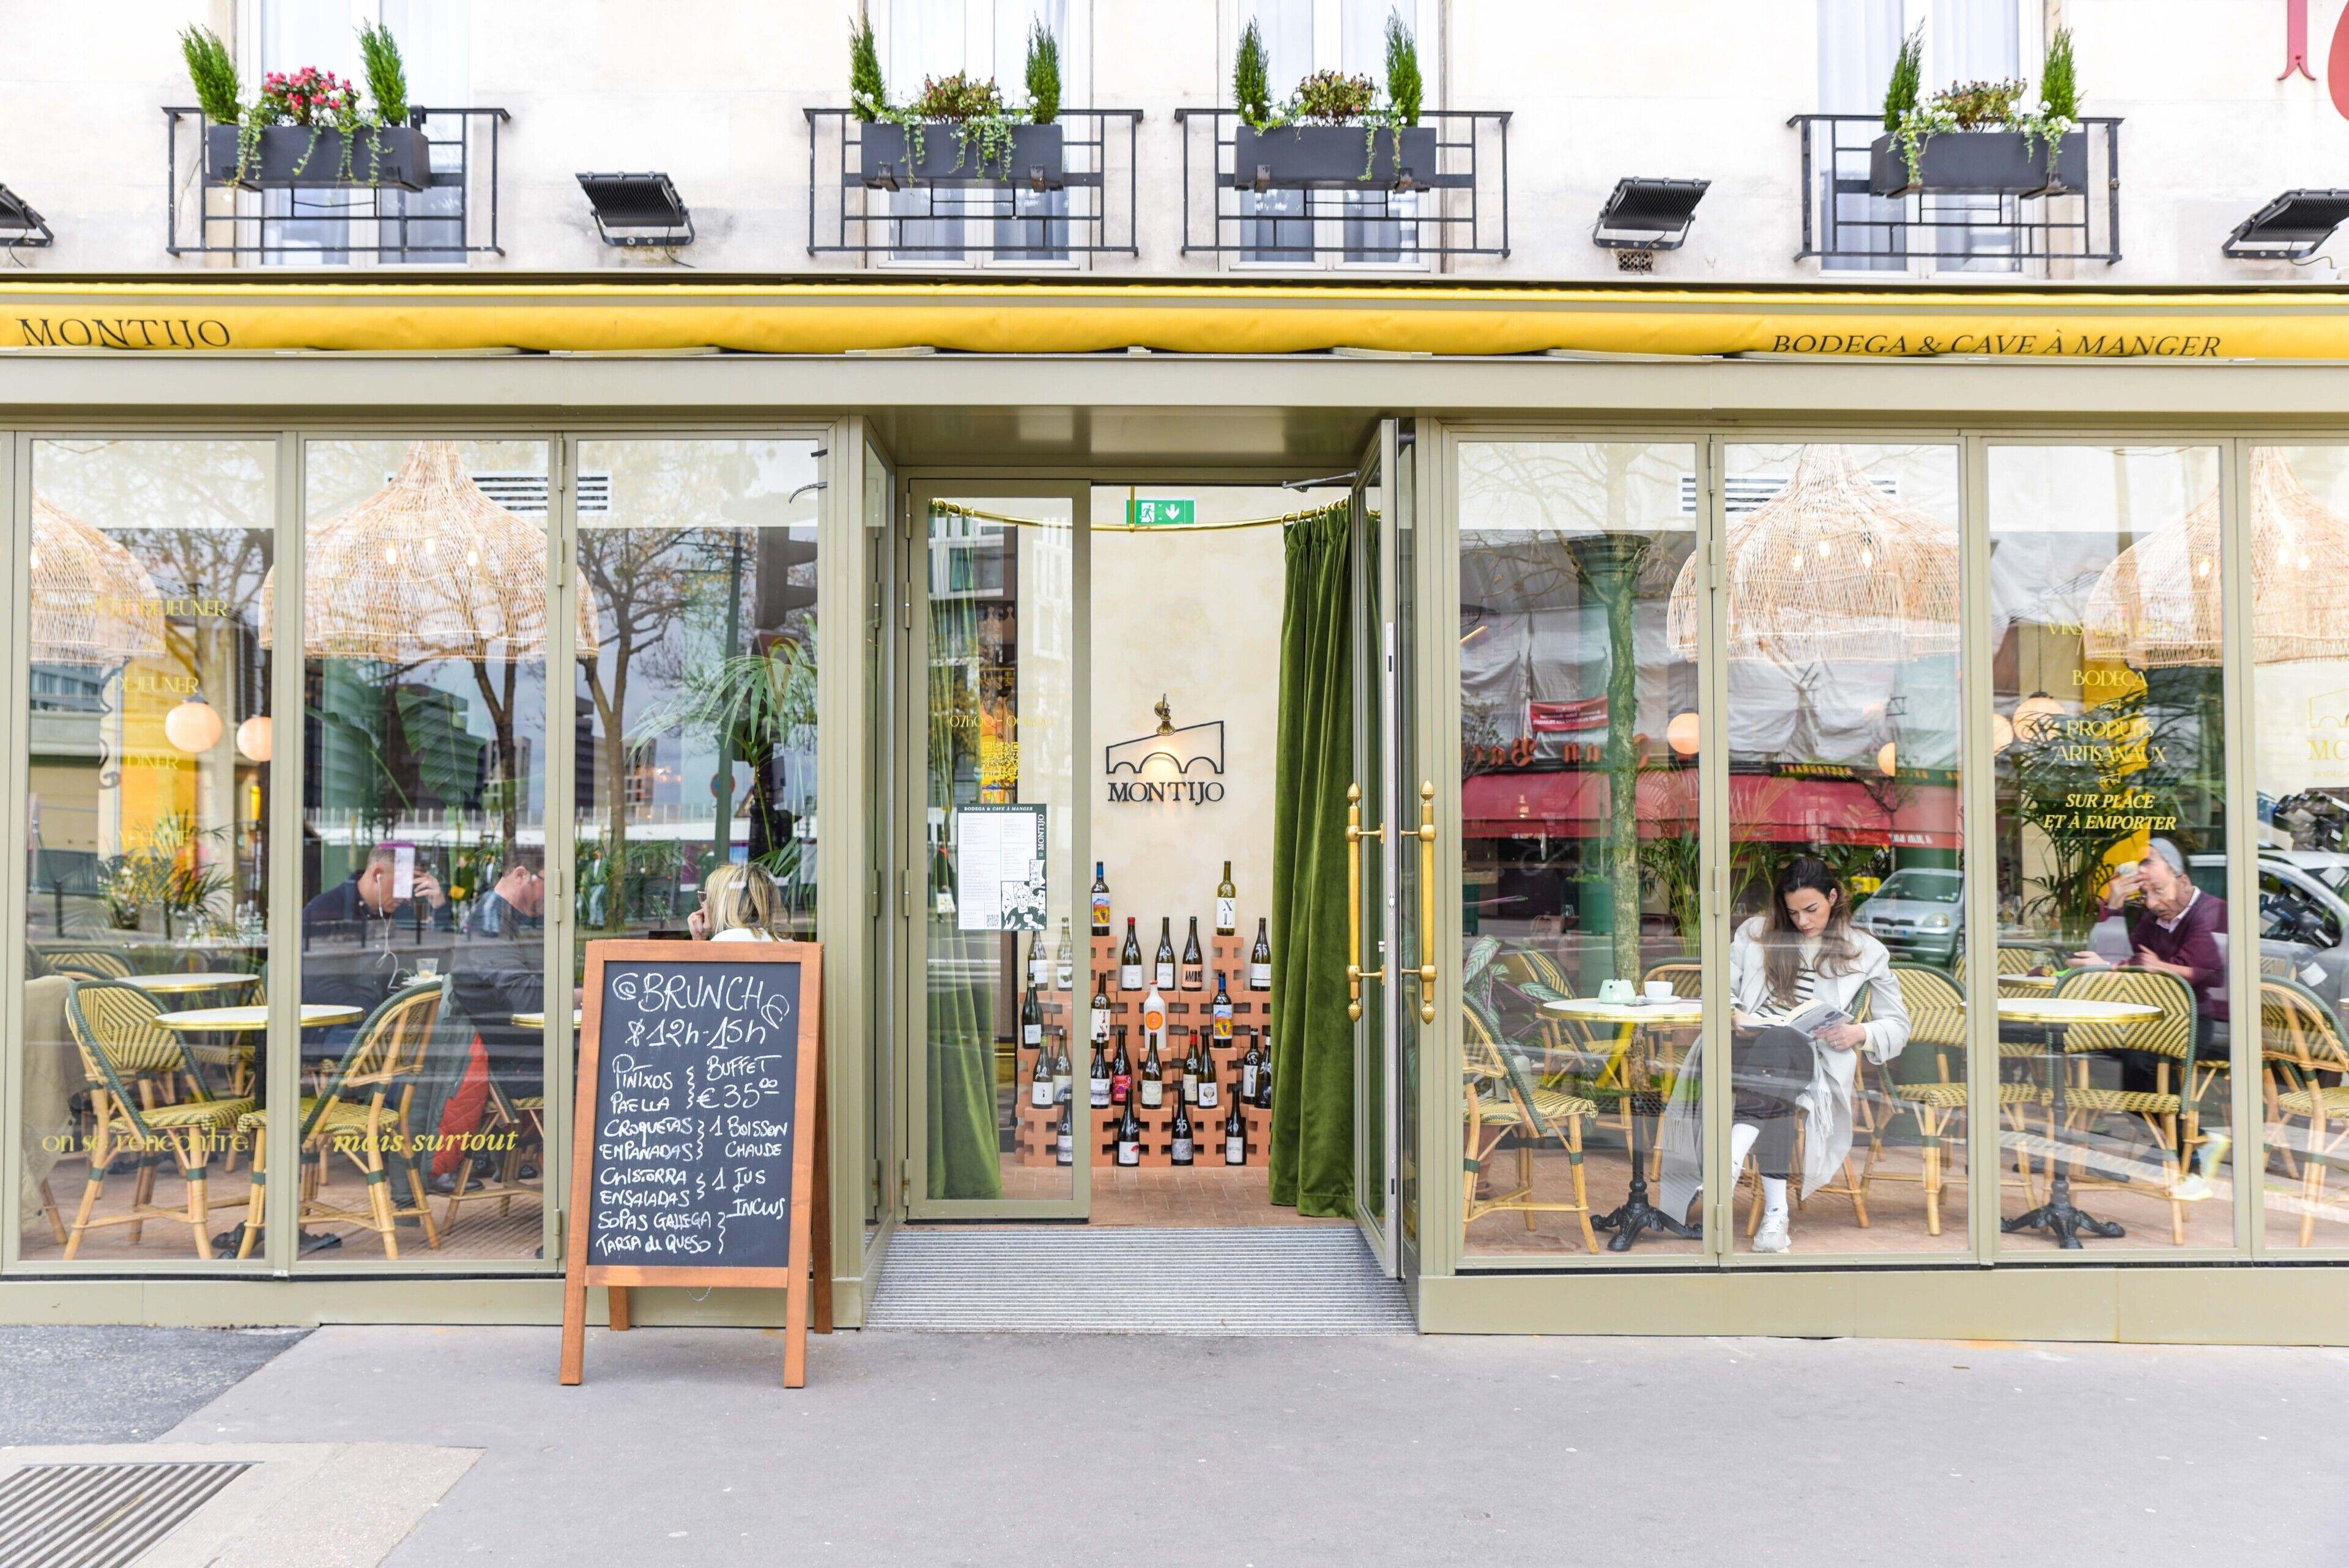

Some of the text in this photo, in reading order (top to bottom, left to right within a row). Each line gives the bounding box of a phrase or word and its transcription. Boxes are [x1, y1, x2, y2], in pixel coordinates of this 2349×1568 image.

[15, 318, 231, 350] MONTIJO
[1772, 329, 2222, 357] BODEGA & CAVE À MANGER
[1108, 782, 1224, 806] MONTIJO
[2065, 793, 2156, 809] SUR PLACE
[2043, 811, 2177, 831] ET À EMPORTER
[638, 972, 764, 1013] BRUNCH
[707, 1055, 782, 1081] BUFFET
[610, 1091, 670, 1114] PAELLA
[604, 1117, 692, 1146] CROQUETAS
[709, 1115, 788, 1137] 1 BOISSON
[42, 1135, 75, 1153] on
[116, 1130, 249, 1153] rencontre
[332, 1129, 519, 1153] mais surtout
[725, 1141, 782, 1158] CHAUDE
[711, 1167, 766, 1193] 1 JUS
[726, 1197, 785, 1219] INCLUS
[597, 1209, 711, 1231] SOPAS GALLEGA
[595, 1233, 641, 1256] TARTA
[666, 1233, 711, 1254] QUESO
